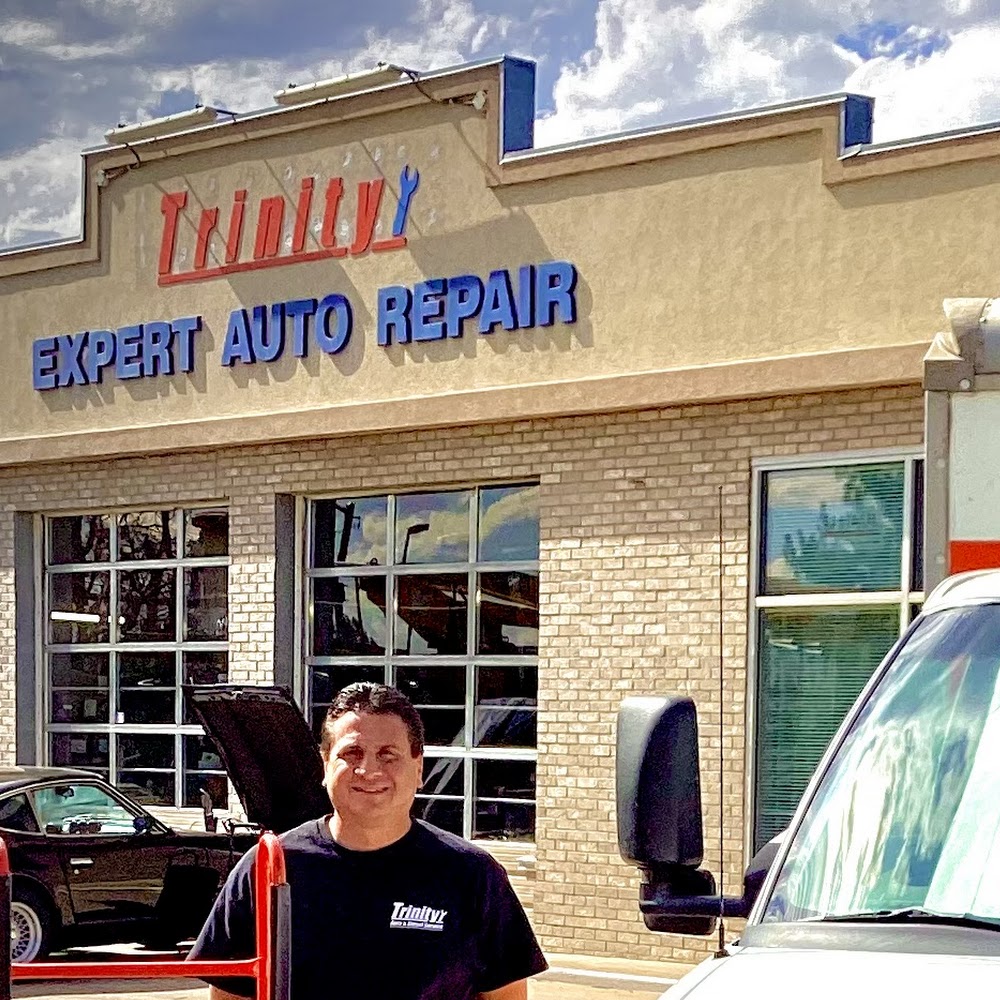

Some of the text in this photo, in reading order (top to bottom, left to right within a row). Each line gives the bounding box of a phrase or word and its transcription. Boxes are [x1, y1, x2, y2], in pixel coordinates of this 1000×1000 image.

[159, 176, 386, 278] Trinity
[33, 260, 578, 391] EXPERT AUTO REPAIR
